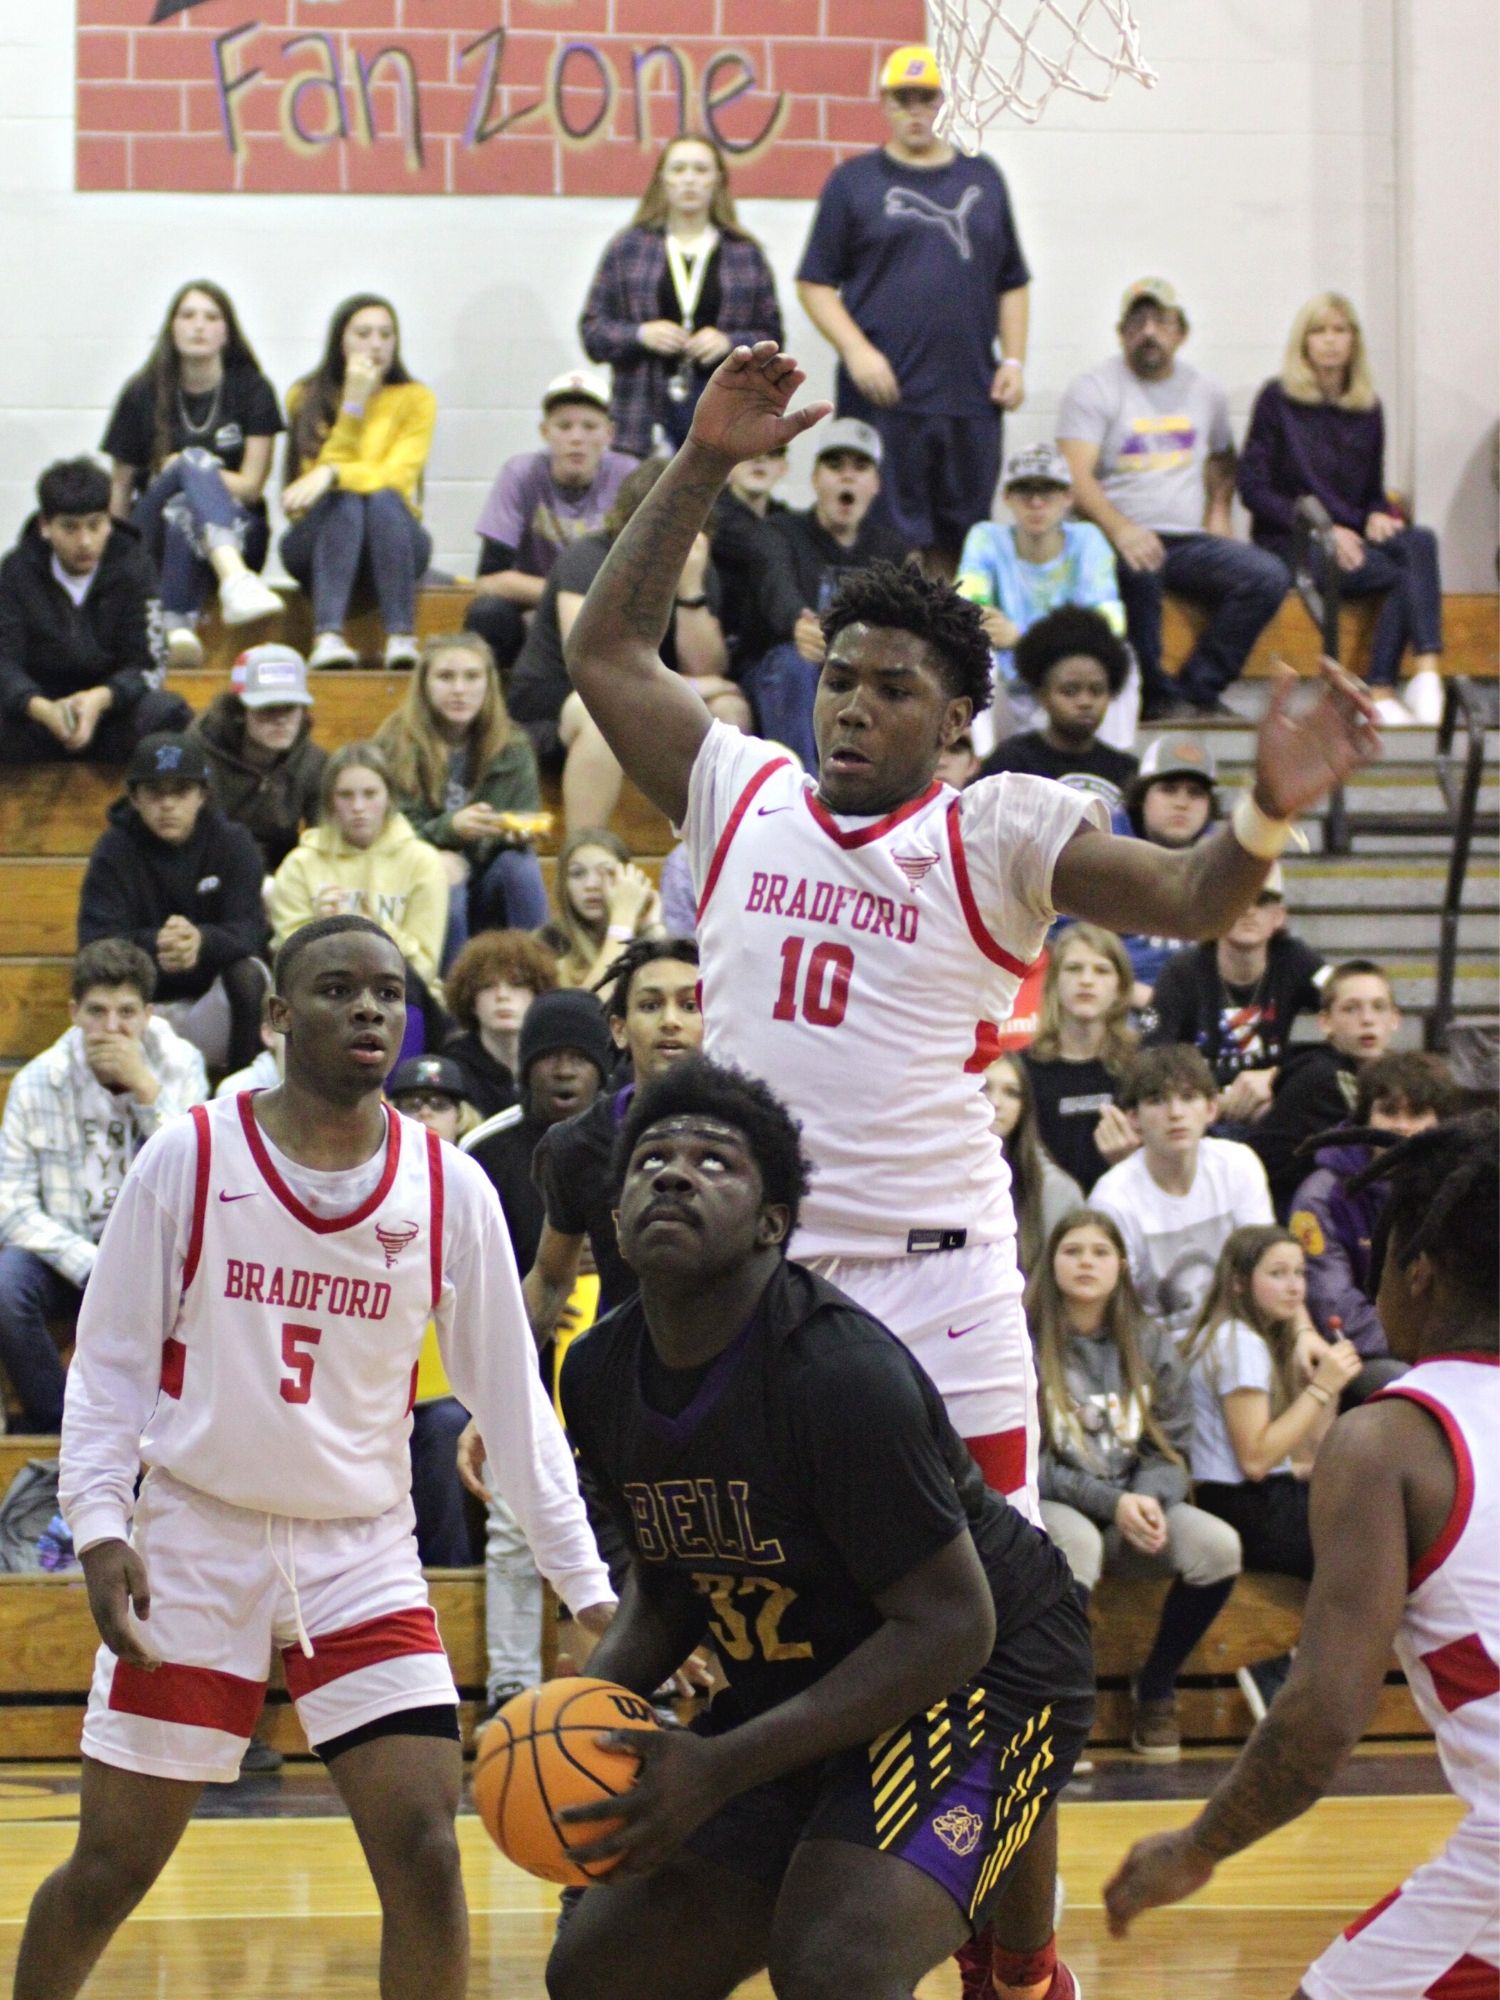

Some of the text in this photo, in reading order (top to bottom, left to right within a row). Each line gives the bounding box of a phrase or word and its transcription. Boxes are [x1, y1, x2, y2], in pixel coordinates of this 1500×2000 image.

[213, 20, 424, 170] Fan
[744, 871, 920, 944] BRADFORD
[771, 935, 855, 1028] 10
[948, 1235, 957, 1246] L
[223, 1258, 393, 1321] BRADFORD
[279, 1322, 323, 1405] 5
[623, 1478, 787, 1566] BELL
[690, 1572, 815, 1663] 32
